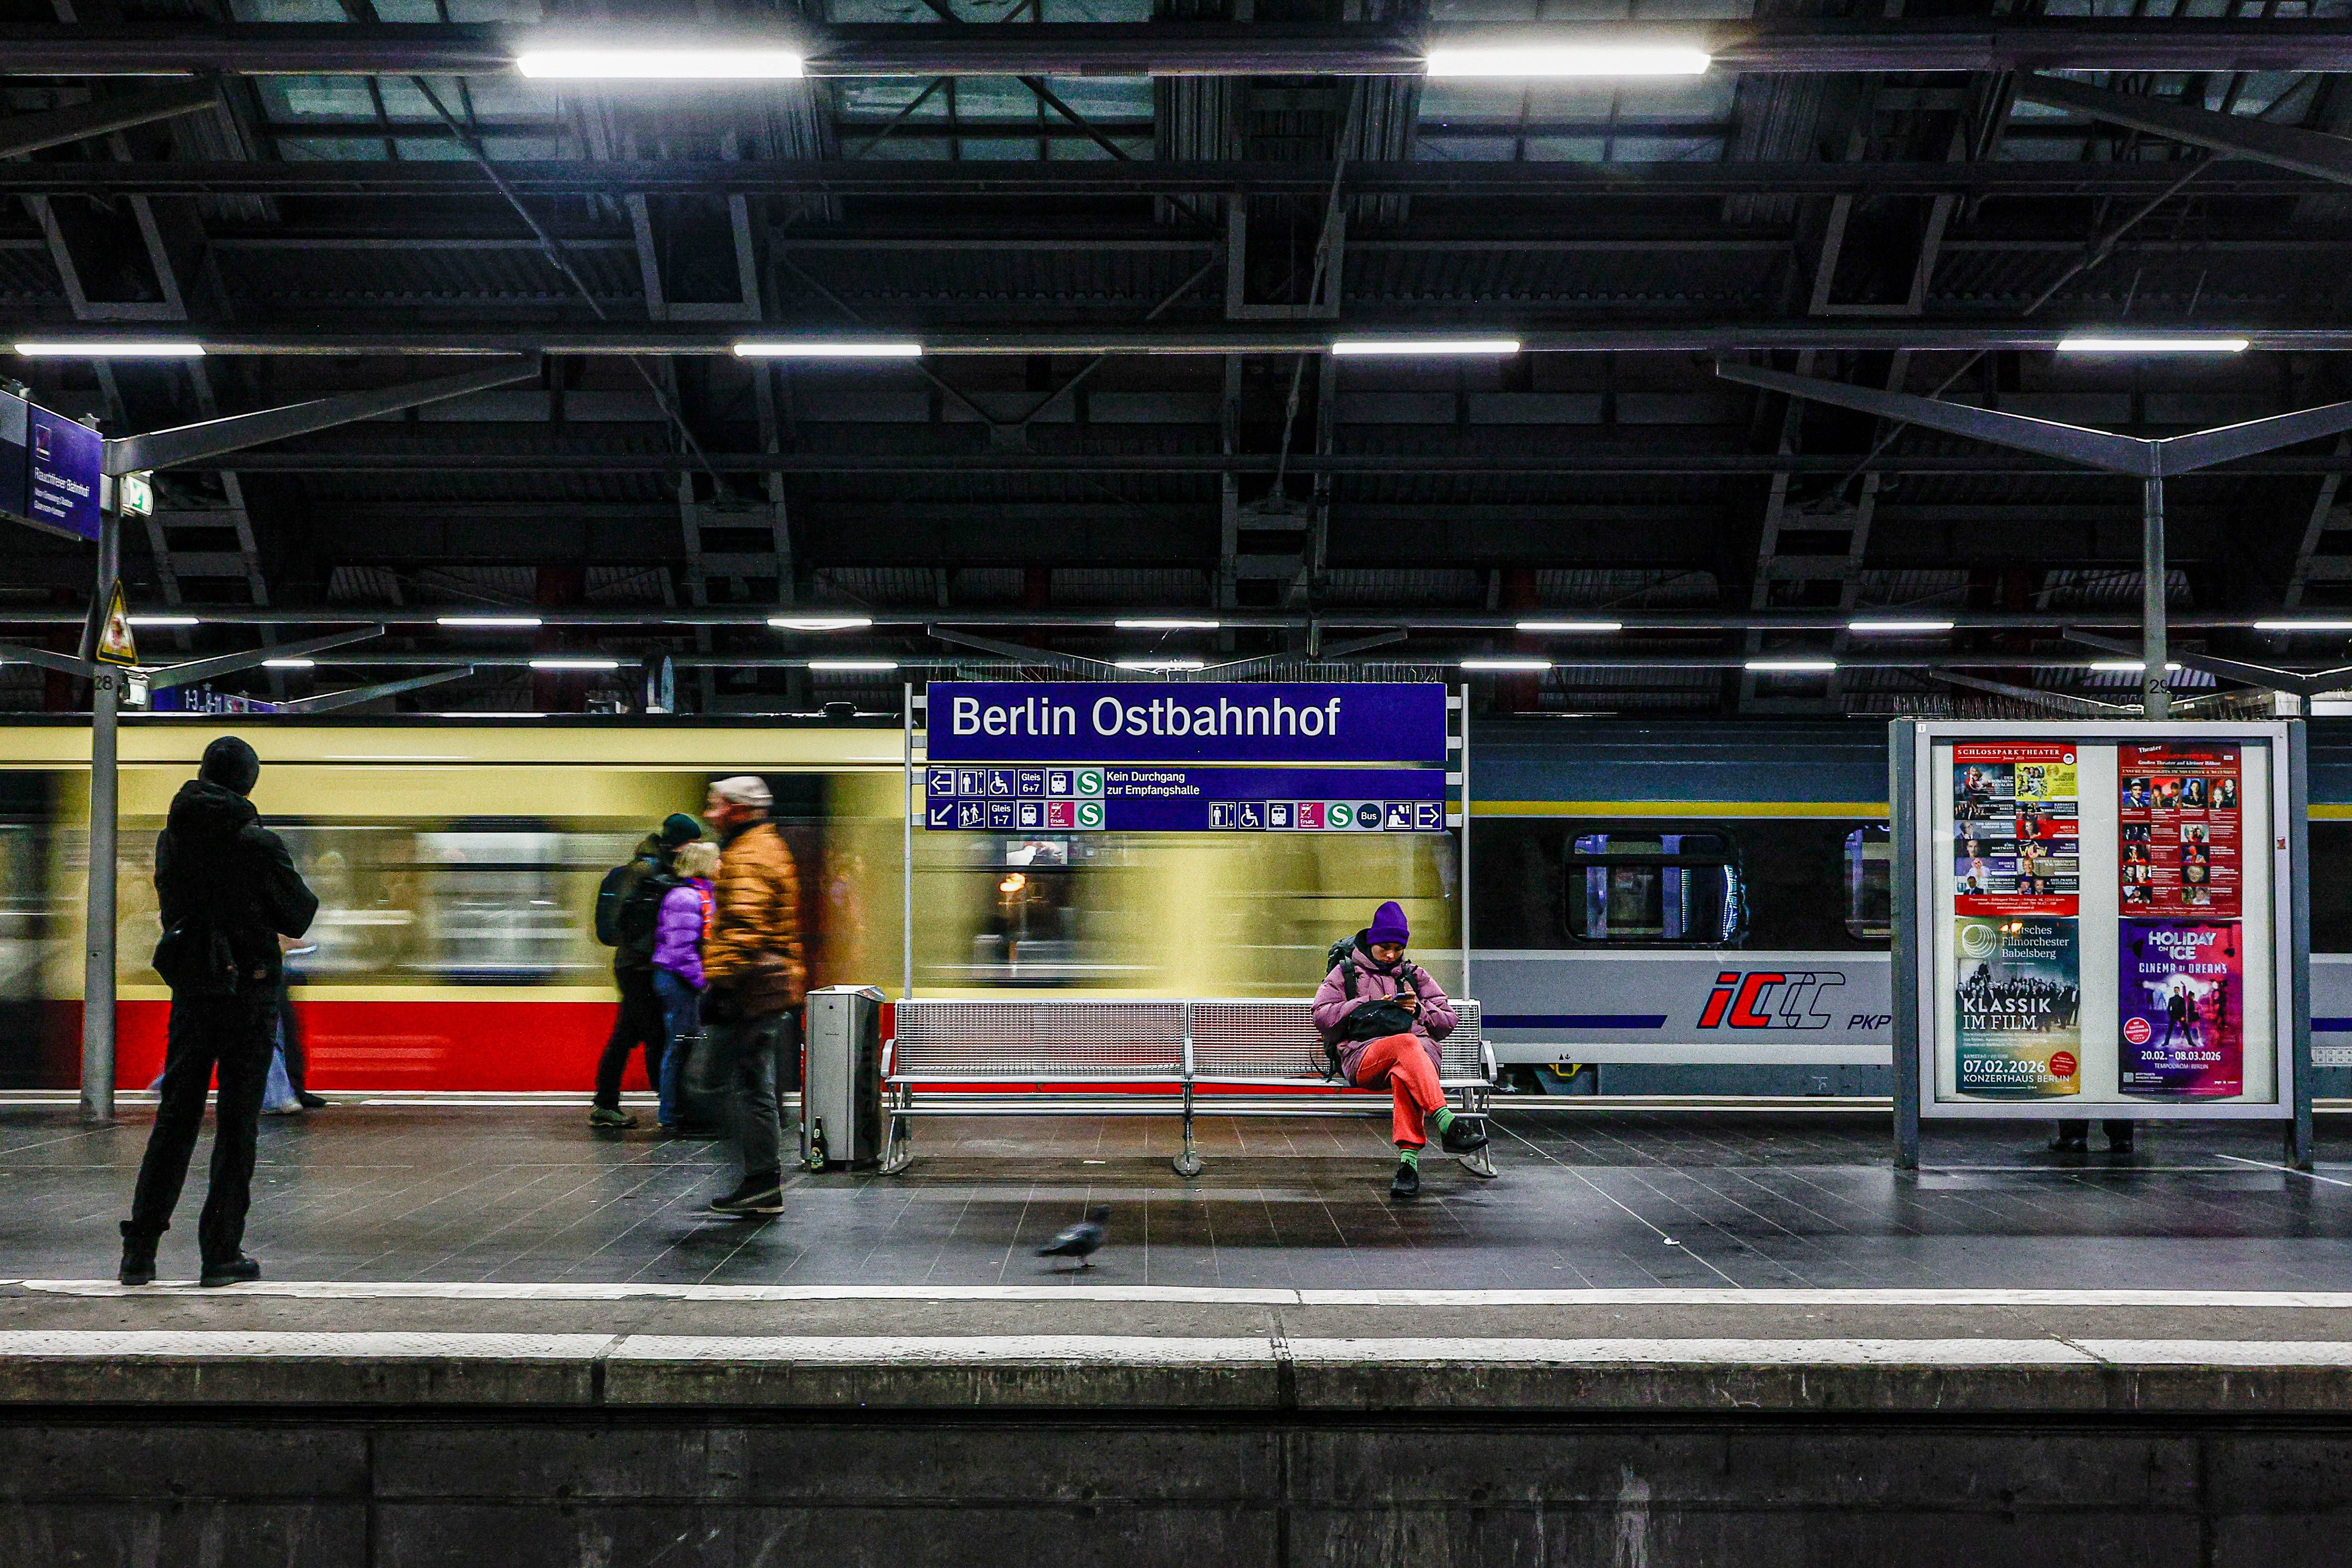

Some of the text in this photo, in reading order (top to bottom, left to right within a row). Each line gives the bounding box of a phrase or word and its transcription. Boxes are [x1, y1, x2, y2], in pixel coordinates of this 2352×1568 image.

[952, 696, 1341, 737] Berlin Ostbahnhof
[1021, 773, 1041, 781] Gleis
[1081, 773, 1099, 793] S
[1106, 771, 1185, 783] Kein Durchgang
[1022, 784, 1039, 792] 6+7
[1125, 785, 1200, 797] Empfangshalle
[994, 816, 1008, 824] 1-7
[1082, 805, 1099, 824] S
[1332, 805, 1349, 825] S
[2002, 925, 2052, 934] tsches
[2002, 937, 2069, 946] Filmorchester
[2148, 931, 2217, 946] HOLIDAY
[2002, 949, 2056, 959] Babelsberg
[2169, 946, 2196, 960] ICE
[2139, 962, 2176, 973] CINEMA
[2189, 962, 2227, 974] DREAMS
[1963, 998, 2051, 1013] KLASSIK
[1847, 1015, 1891, 1030] PKP
[1963, 1015, 2037, 1030] IM FILM
[2141, 1051, 2167, 1060] 20.02.
[2175, 1051, 2221, 1061] 08.03.2026
[1963, 1060, 2045, 1073] 07.02.2026
